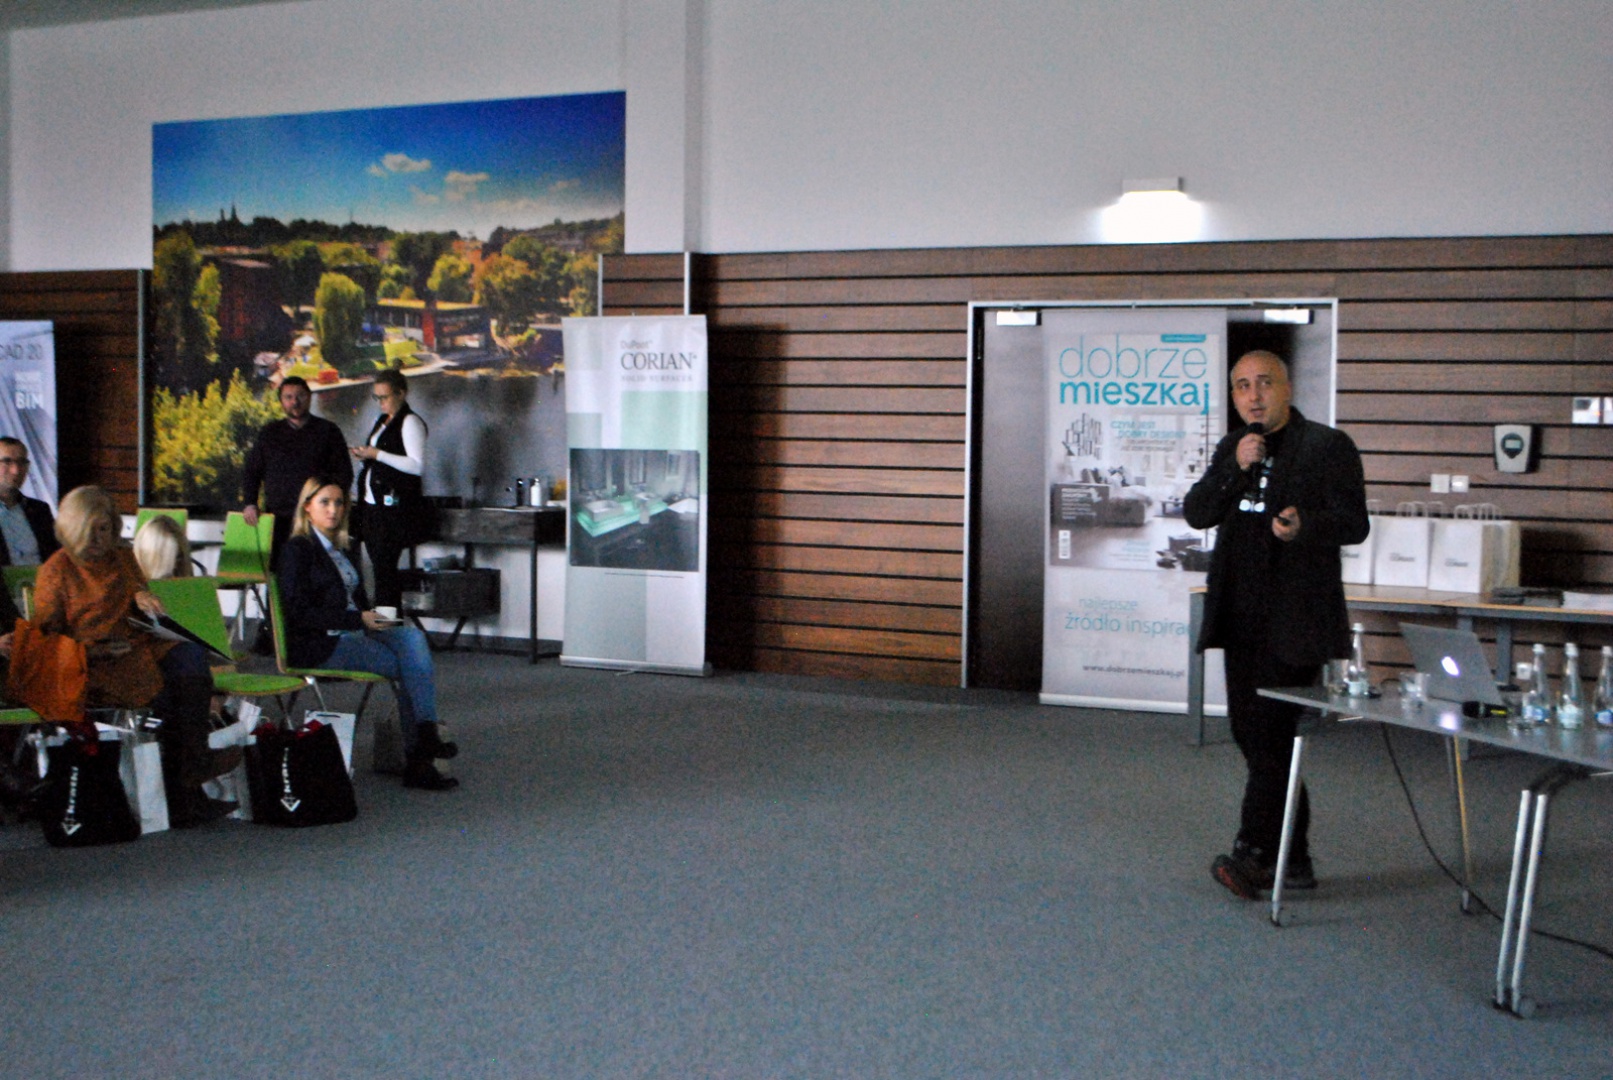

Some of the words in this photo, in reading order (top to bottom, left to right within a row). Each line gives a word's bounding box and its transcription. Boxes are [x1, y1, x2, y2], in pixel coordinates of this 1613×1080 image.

[620, 351, 693, 371] CORIAN
[1058, 333, 1208, 379] dobrze
[1059, 381, 1210, 415] mieszkaj
[1079, 598, 1138, 612] najlepsze
[1064, 613, 1121, 633] źródło
